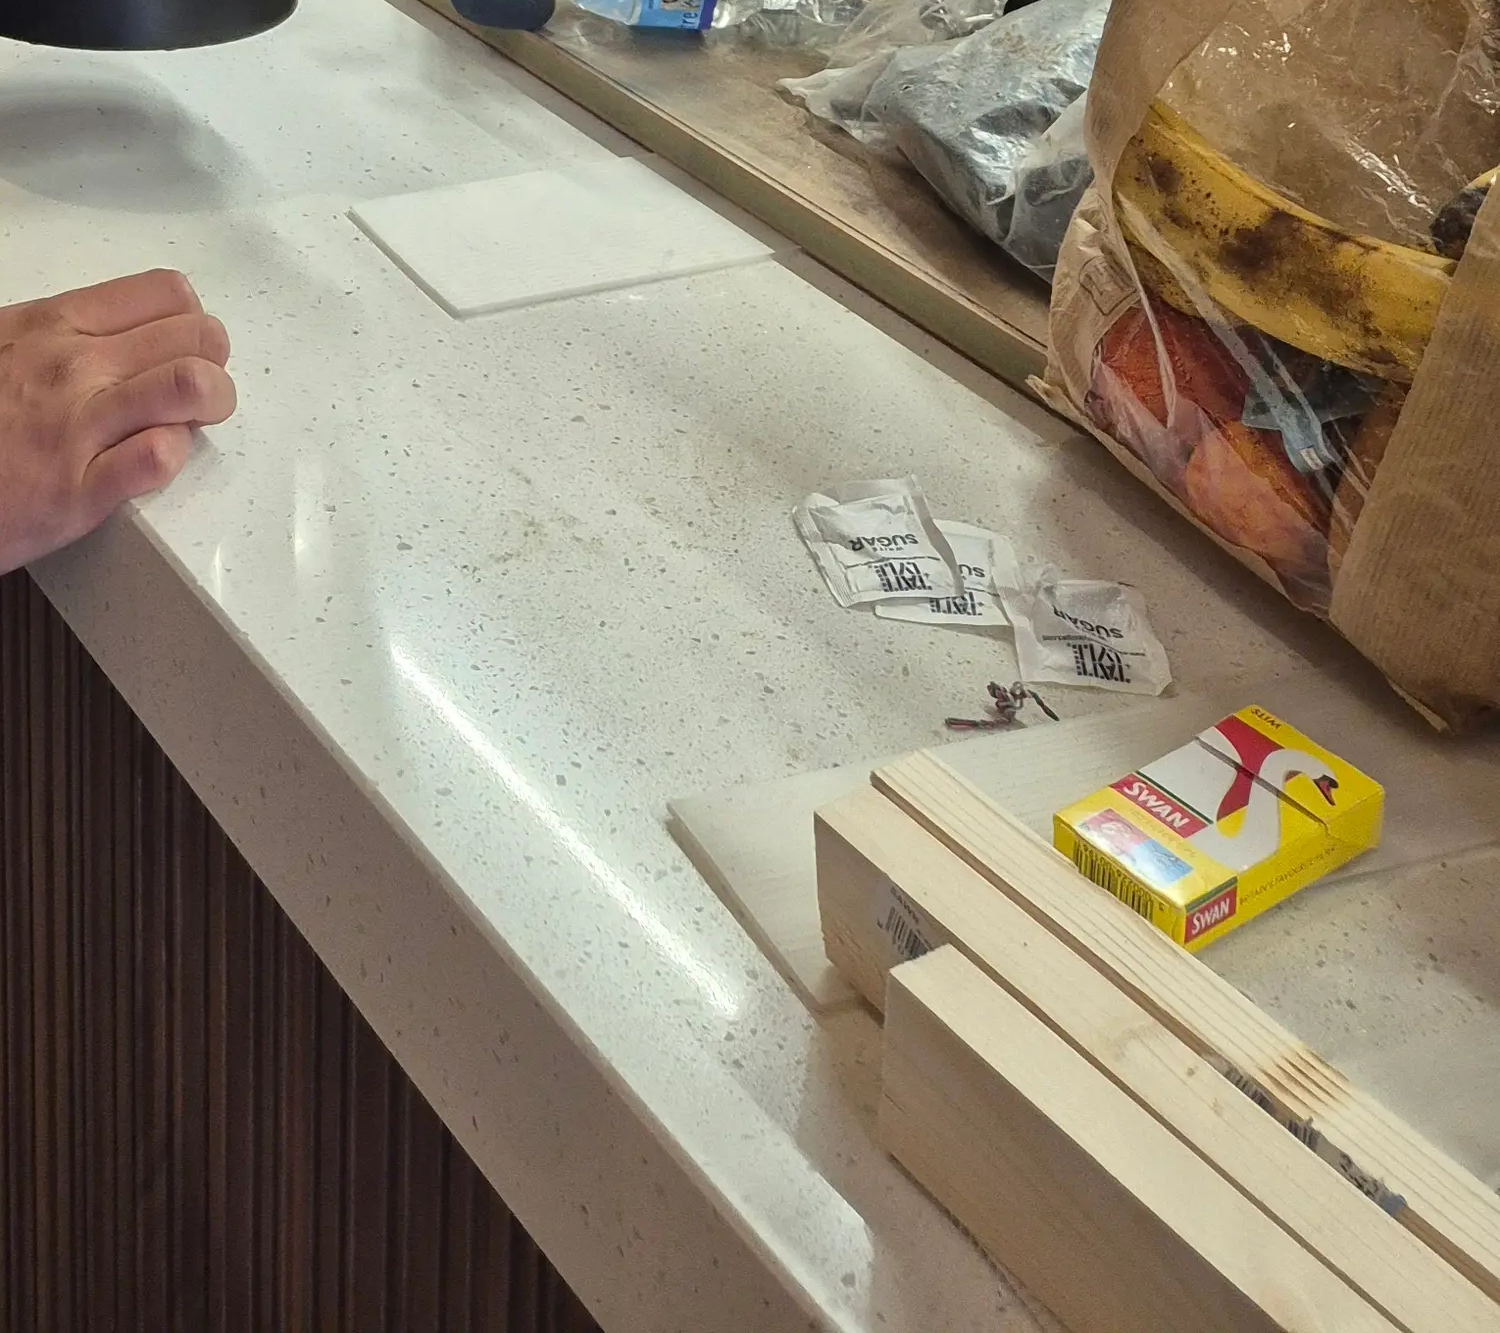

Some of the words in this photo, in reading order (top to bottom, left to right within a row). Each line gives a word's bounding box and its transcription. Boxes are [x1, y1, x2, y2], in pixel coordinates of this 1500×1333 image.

[850, 533, 919, 552] SUGAR
[880, 574, 933, 593] TATE
[1052, 604, 1125, 639] SUGAR
[1123, 781, 1190, 829] SWAN
[1191, 897, 1231, 936] SWAN
